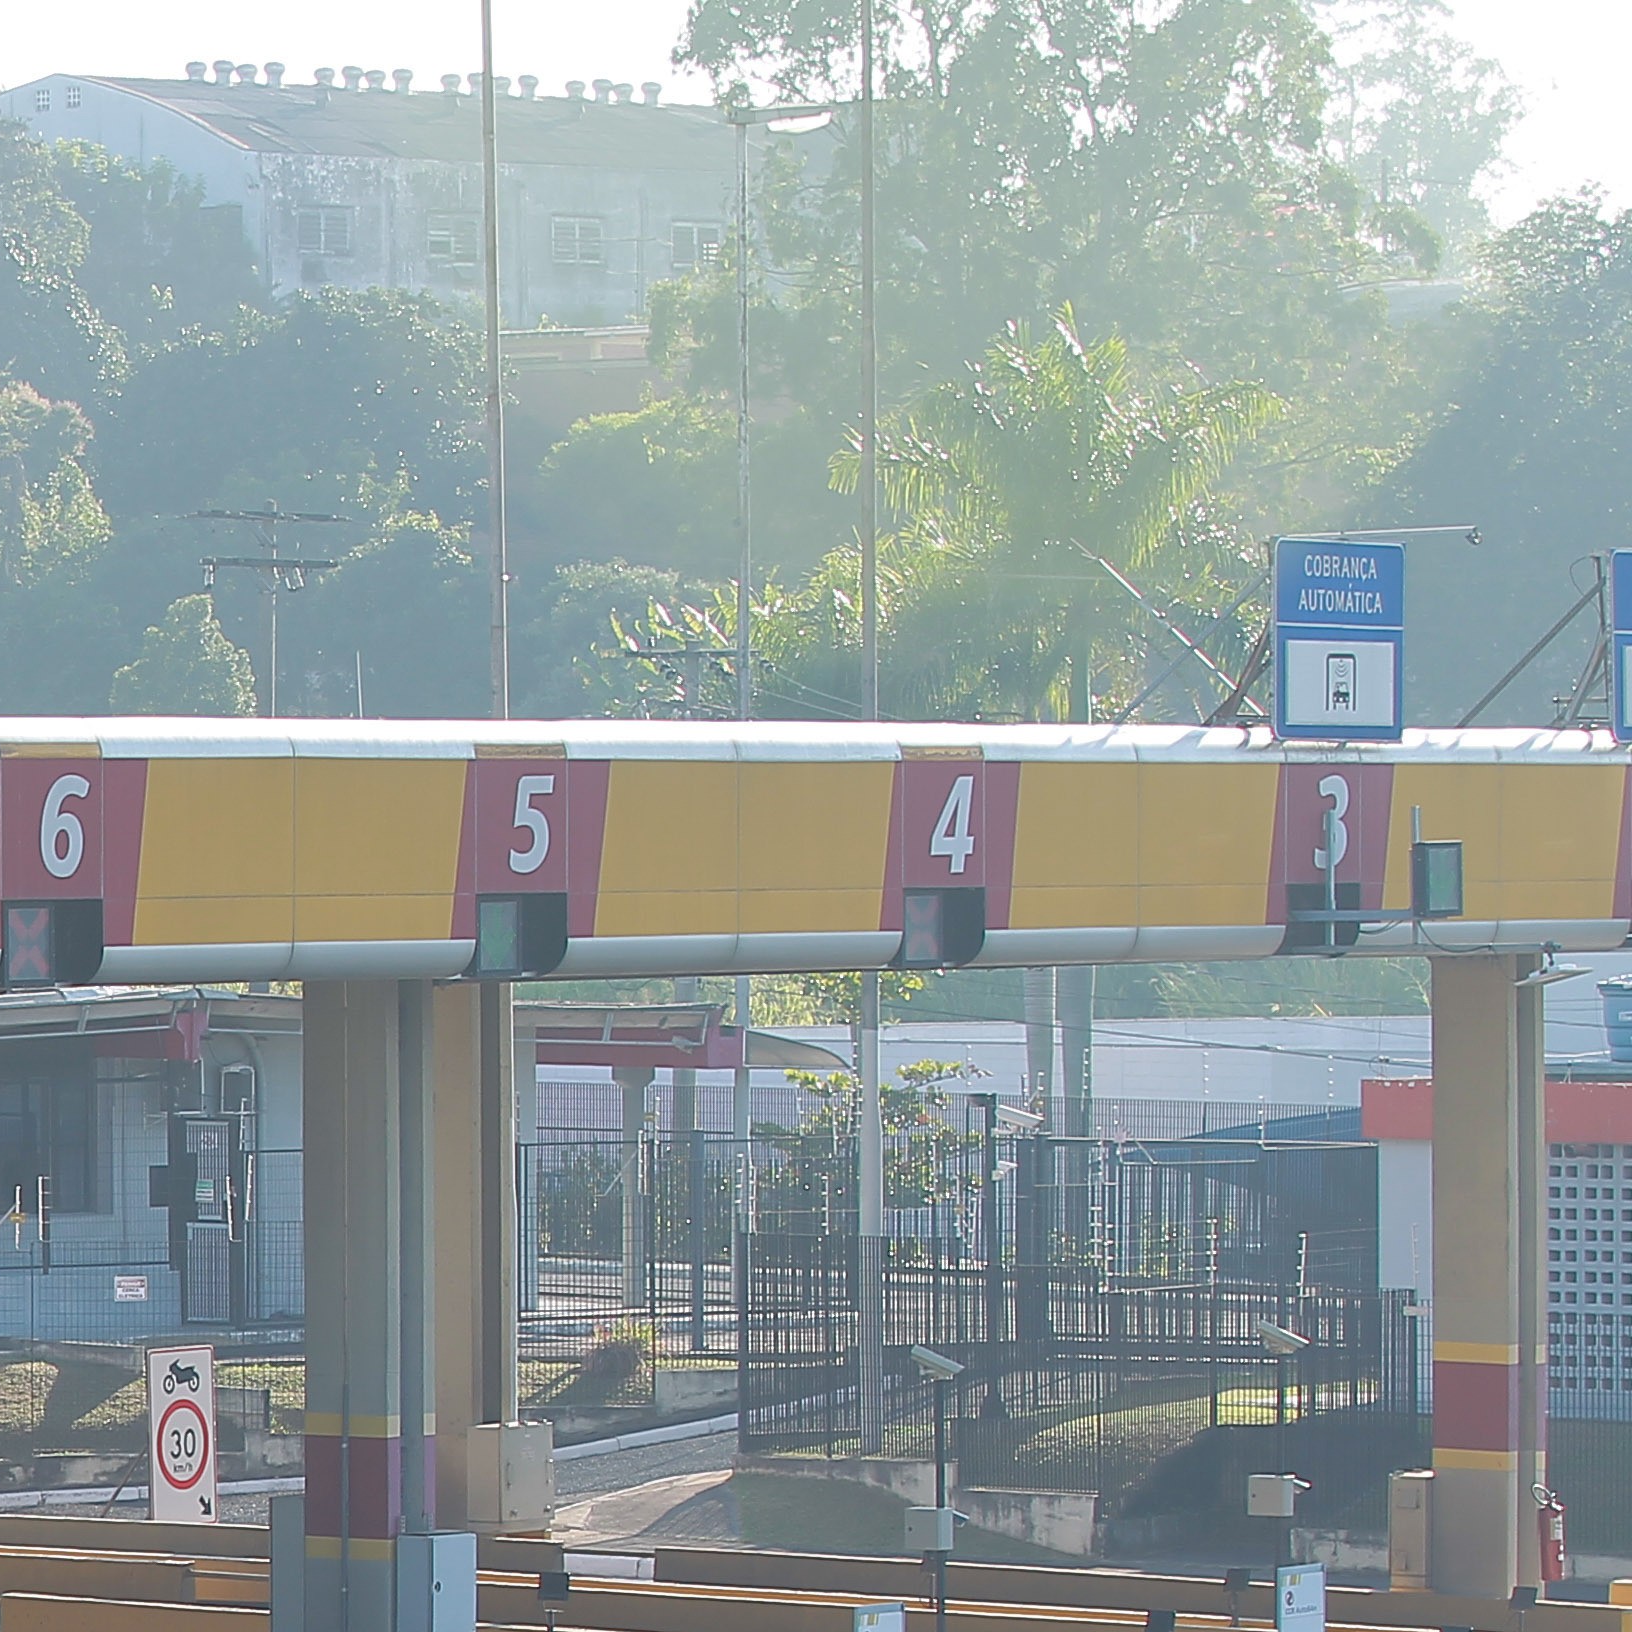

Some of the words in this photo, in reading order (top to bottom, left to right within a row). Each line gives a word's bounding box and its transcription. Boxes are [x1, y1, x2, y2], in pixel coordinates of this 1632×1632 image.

[1298, 582, 1383, 614] AUTOMÁTICA
[1304, 554, 1377, 581] COBRANÇA
[40, 773, 88, 880] 6
[508, 771, 556, 876] 5
[927, 773, 977, 874] 4
[1313, 774, 1351, 870] 3
[170, 1428, 196, 1459] 30
[173, 1463, 193, 1473] km/h
